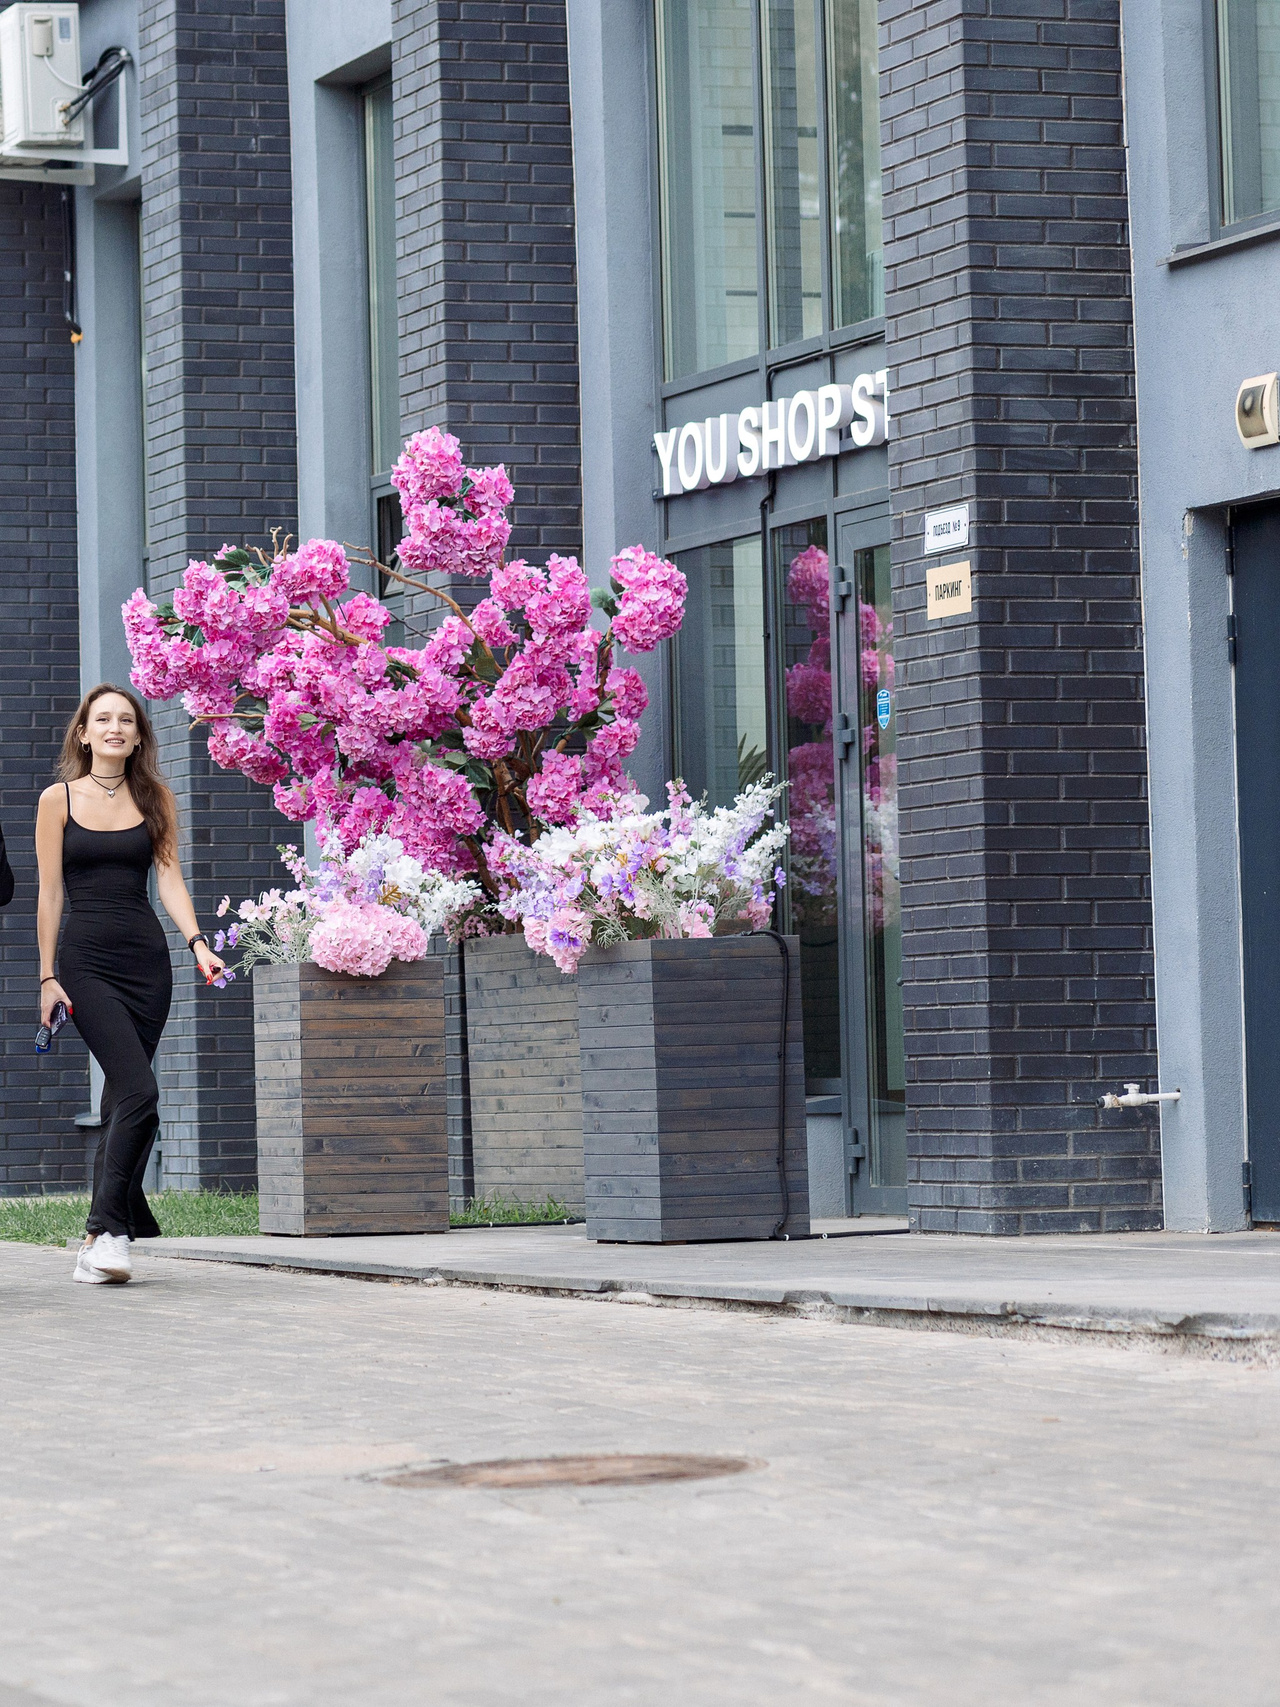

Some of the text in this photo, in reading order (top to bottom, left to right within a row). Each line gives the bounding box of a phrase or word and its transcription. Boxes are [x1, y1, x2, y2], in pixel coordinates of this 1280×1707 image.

[653, 413, 737, 495] YOU
[736, 383, 851, 477] SHOP
[934, 579, 963, 601] ПАРКИНГ
